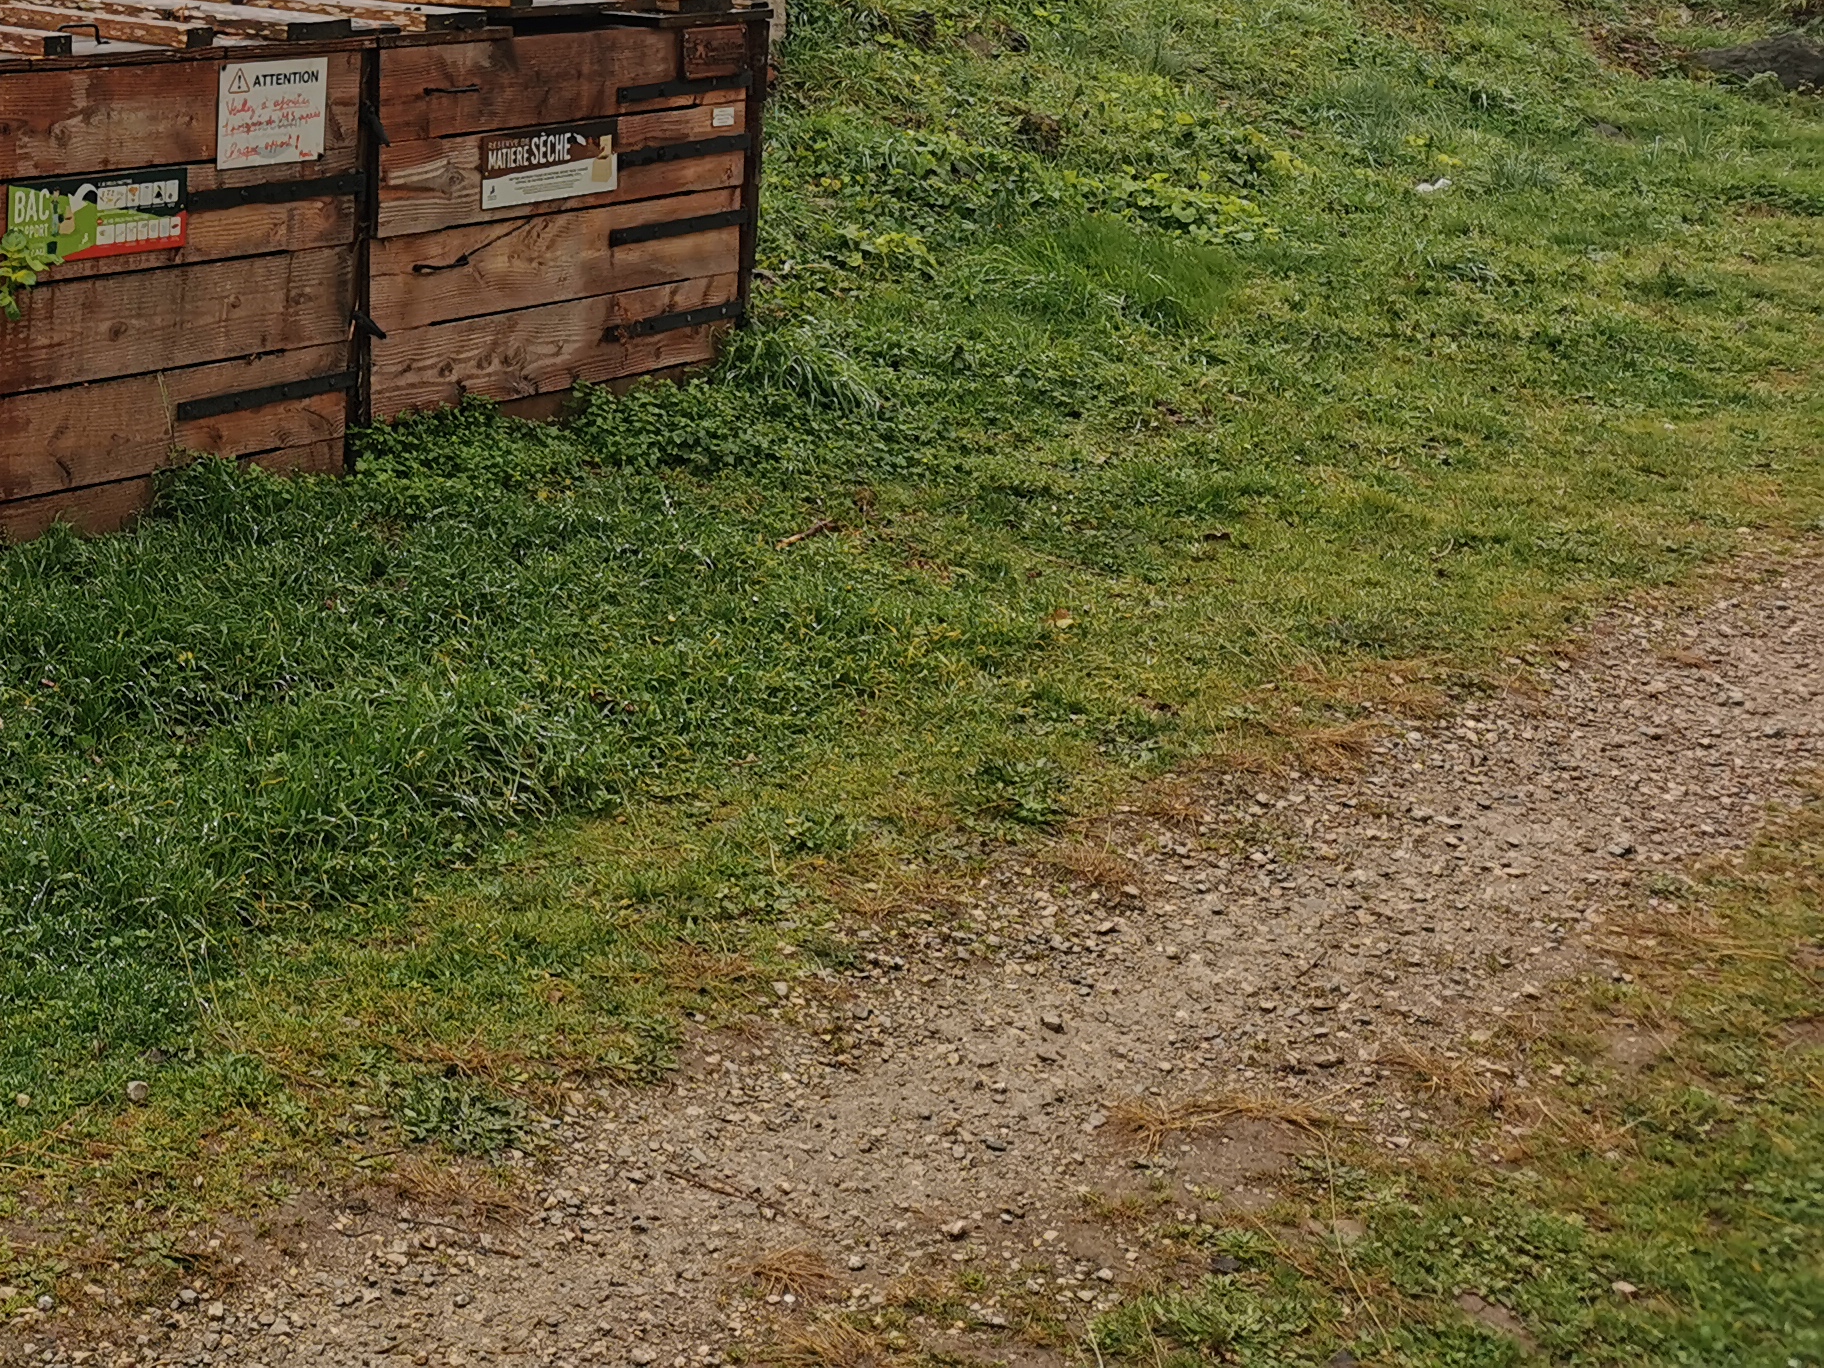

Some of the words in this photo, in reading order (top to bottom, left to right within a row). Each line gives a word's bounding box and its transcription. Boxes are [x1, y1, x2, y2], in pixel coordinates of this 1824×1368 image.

[253, 70, 319, 88] ATTENTION
[531, 132, 571, 165] SÈCHE
[14, 188, 50, 224] BAC
